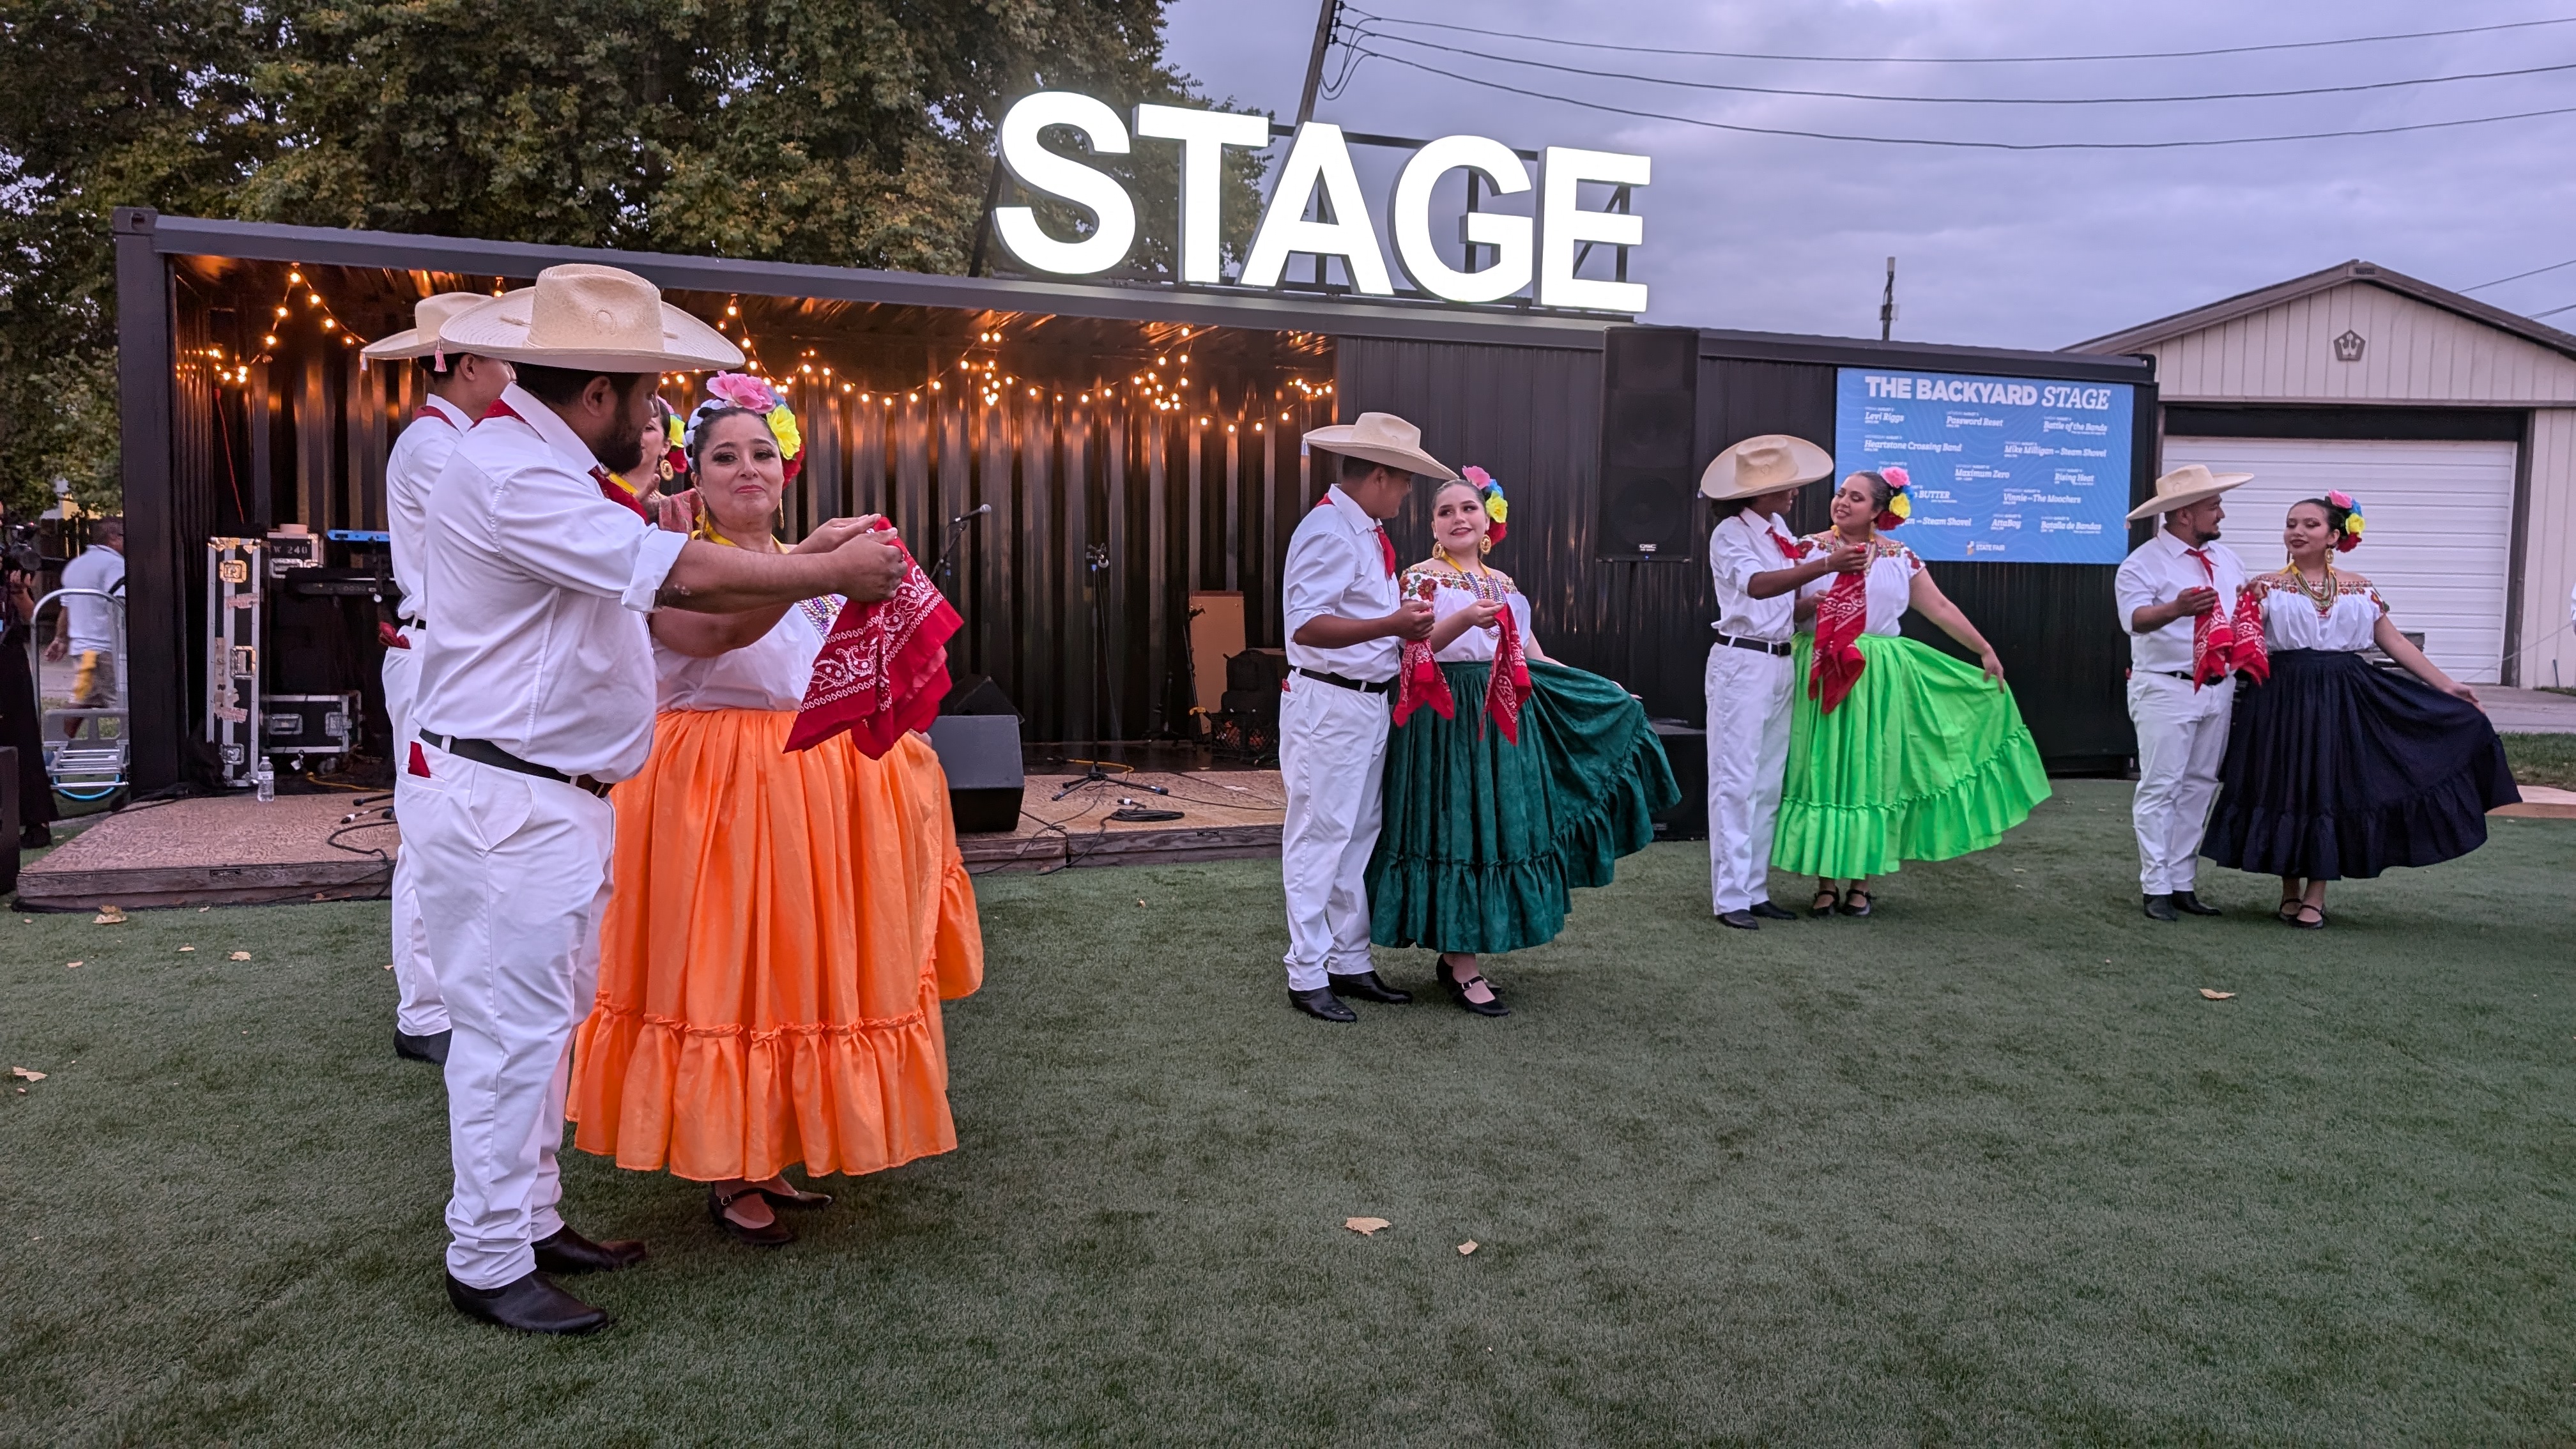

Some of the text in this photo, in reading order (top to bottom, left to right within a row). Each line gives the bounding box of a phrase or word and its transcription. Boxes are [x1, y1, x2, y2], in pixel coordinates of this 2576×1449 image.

[993, 90, 1652, 313] STAGE
[1865, 376, 2111, 411] THE BACKYARD STAGE
[1865, 411, 1904, 424] Levi Riggs
[1946, 416, 2003, 427] Password Reset
[2044, 420, 2107, 432] Battle of the Bands
[1864, 440, 1962, 453] Heartstone Crossing Band
[2004, 445, 2022, 454] Mike
[2023, 446, 2053, 457] Milligan
[2060, 447, 2082, 457] Steam
[2083, 448, 2106, 457] Shovel
[1955, 468, 2010, 479] Maximum Zero
[2055, 473, 2094, 484] Rising Heat
[1919, 490, 1950, 498] BUTTER
[2047, 494, 2082, 503] Moochers
[1922, 517, 1946, 525] Steam
[1947, 518, 1972, 526] Shovel
[2066, 521, 2074, 530] de
[2076, 522, 2102, 530] Bandas
[287, 546, 307, 554] 240
